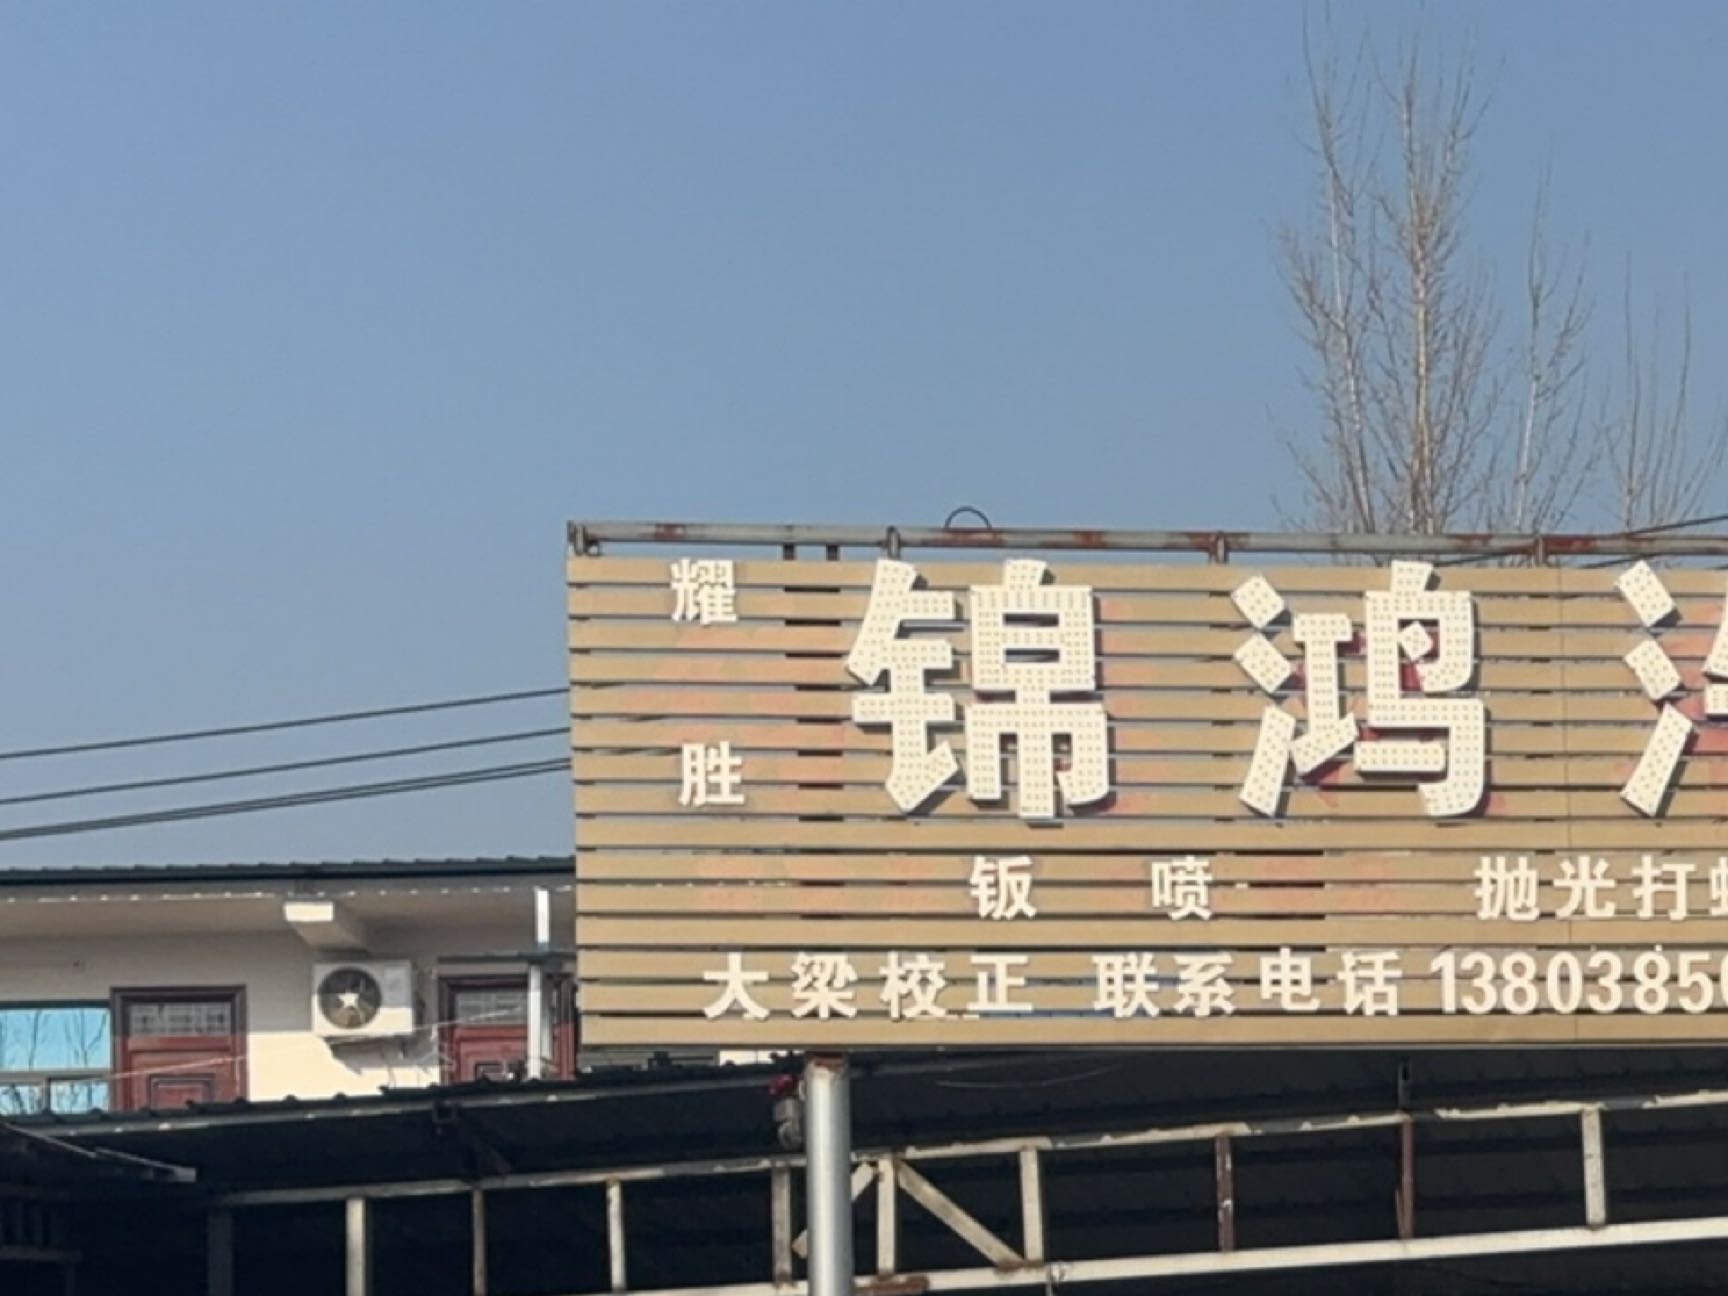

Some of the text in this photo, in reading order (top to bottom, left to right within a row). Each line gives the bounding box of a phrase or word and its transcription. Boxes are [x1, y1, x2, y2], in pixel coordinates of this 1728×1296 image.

[702, 950, 1032, 1021] 大梁校正
[1092, 947, 1402, 1018] 联系电话
